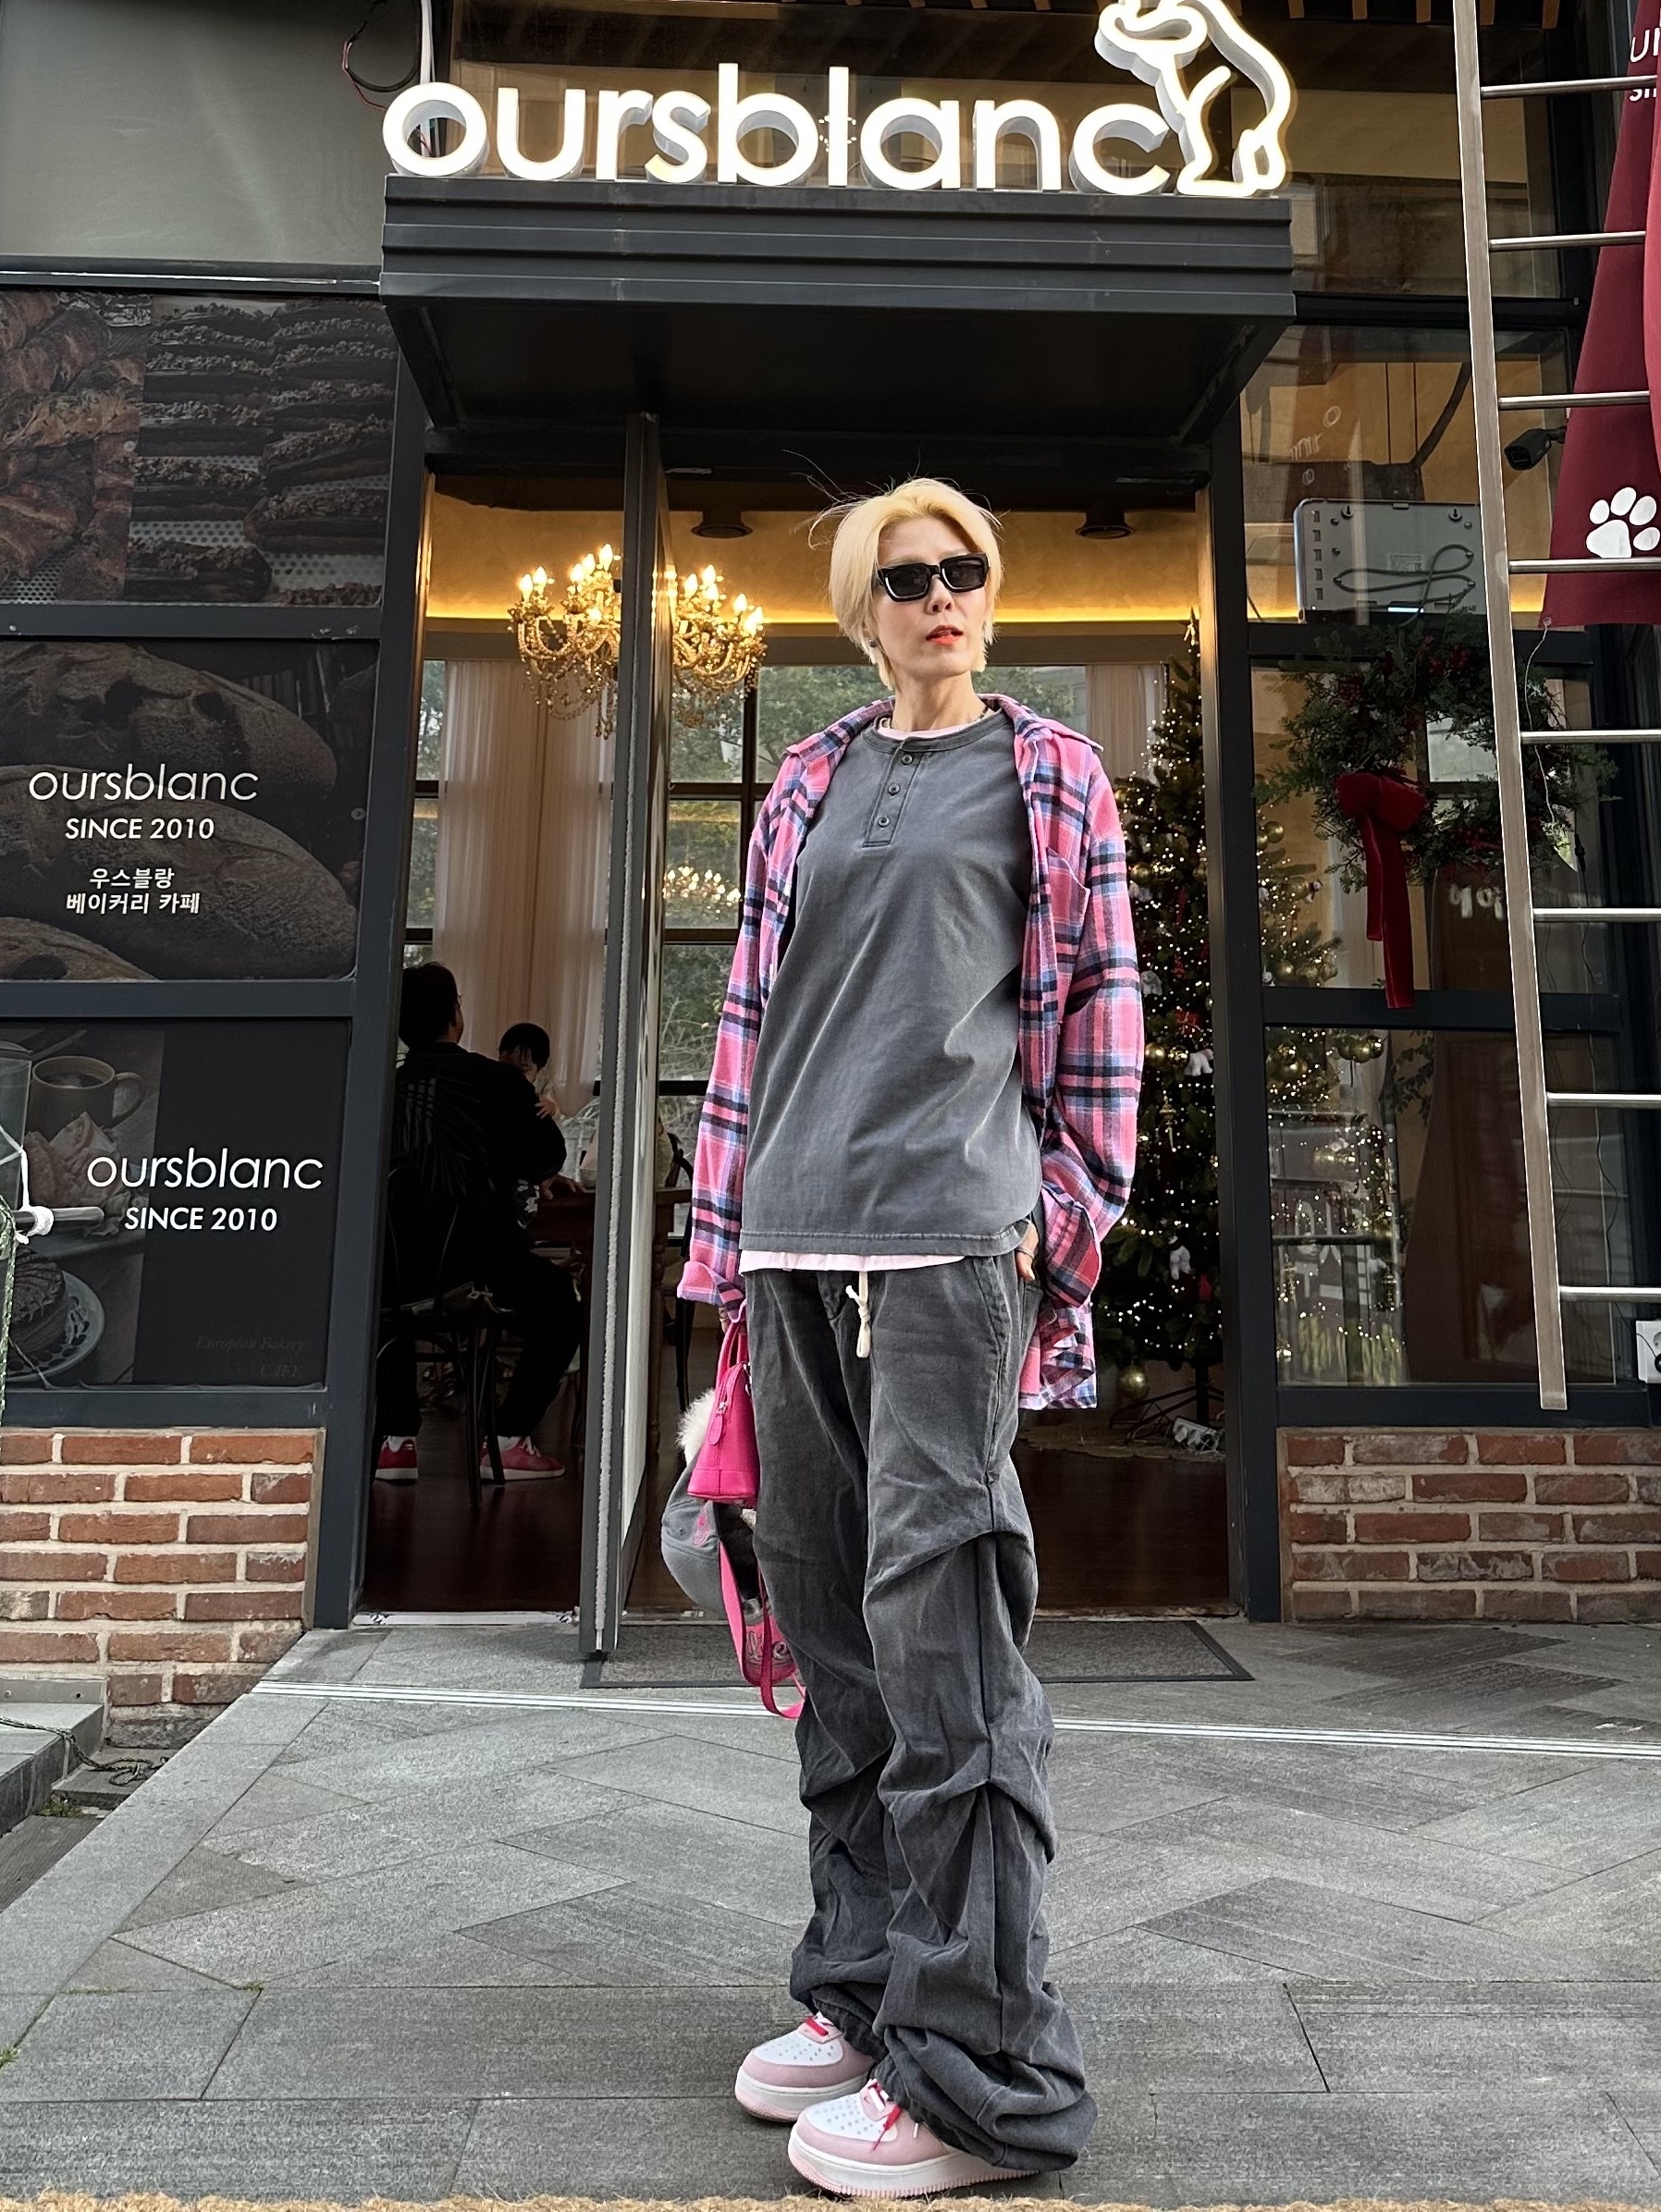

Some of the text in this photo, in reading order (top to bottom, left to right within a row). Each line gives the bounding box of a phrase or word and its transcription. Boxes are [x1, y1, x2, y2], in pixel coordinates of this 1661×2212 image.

[382, 62, 1171, 196] oursblanc
[29, 763, 259, 801] oursblanc
[65, 817, 215, 840] SINCE 2010
[89, 867, 175, 890] 우스블랑
[66, 892, 200, 915] 베이커리 카페
[87, 1147, 324, 1189] oursblanc
[124, 1207, 277, 1231] SINCE 2010
